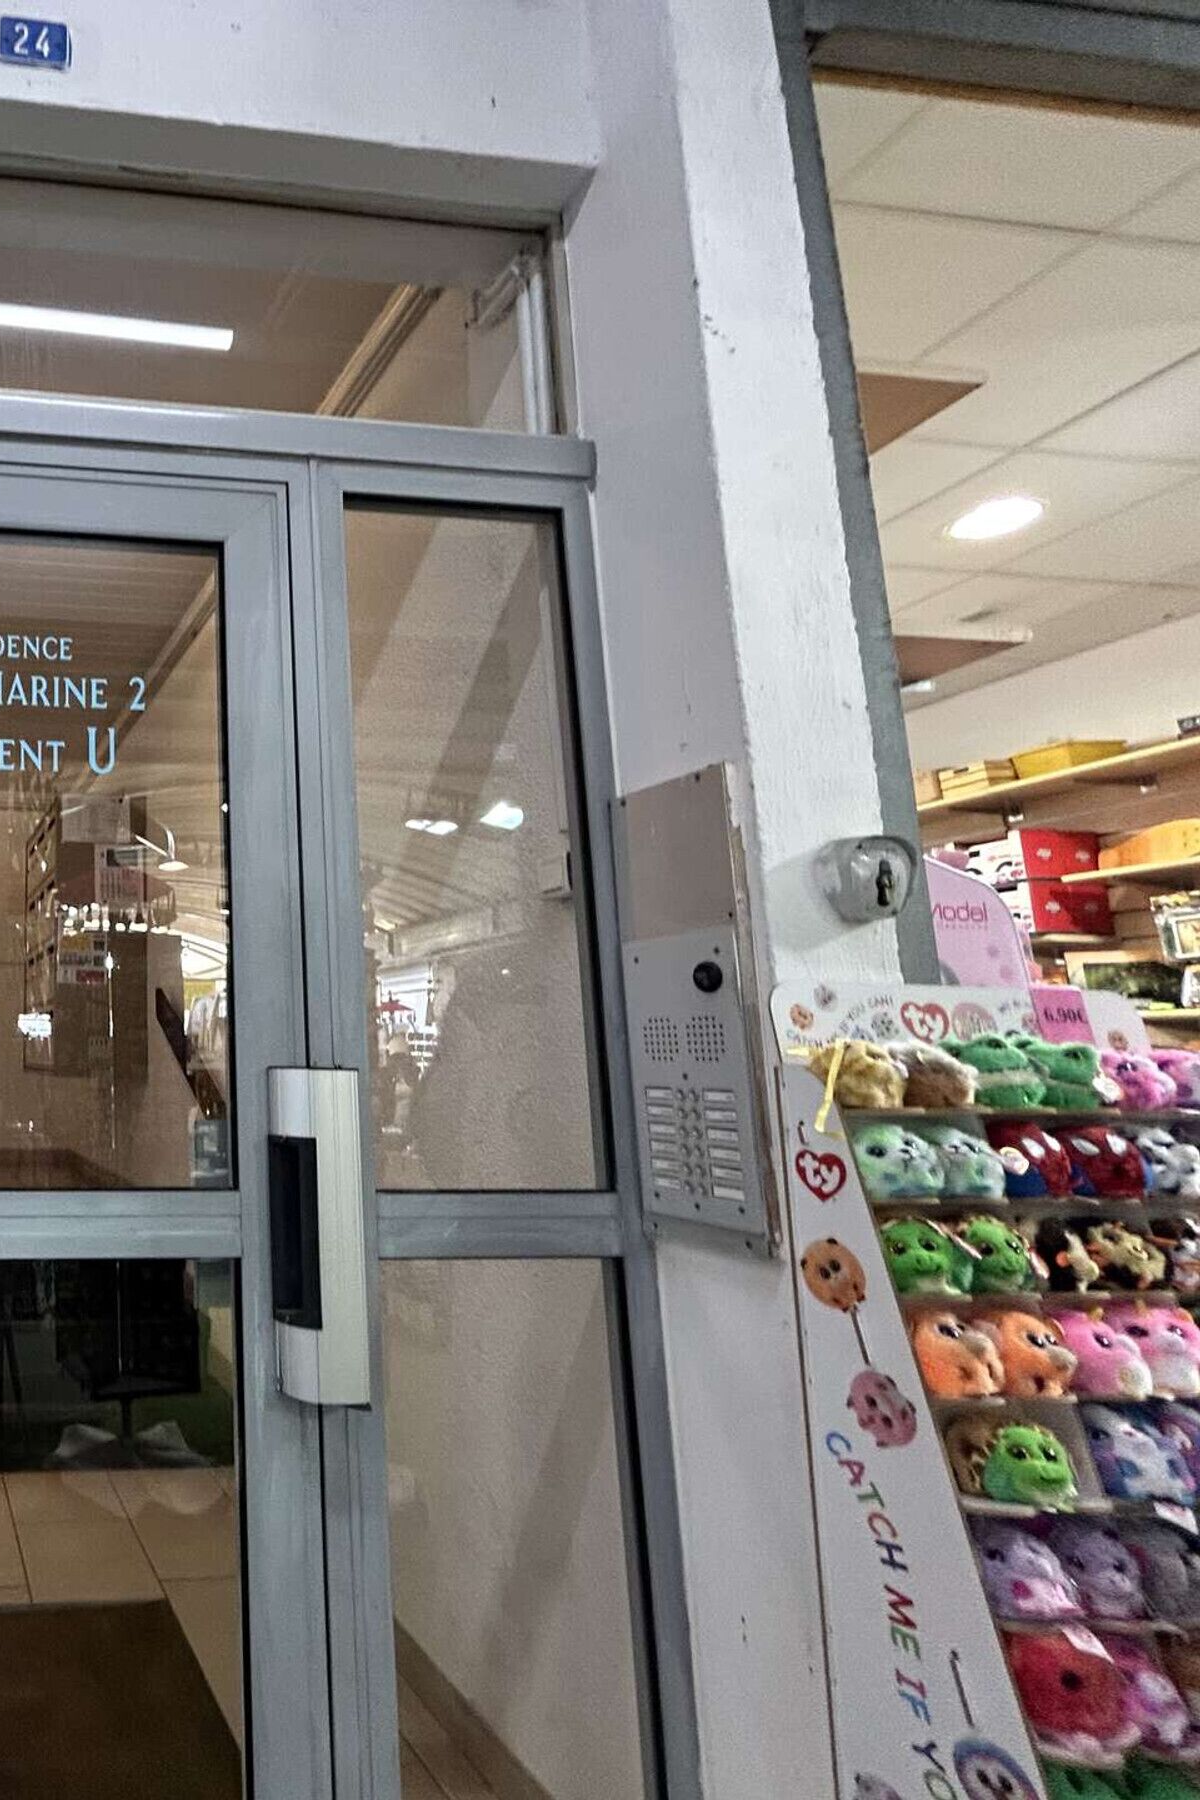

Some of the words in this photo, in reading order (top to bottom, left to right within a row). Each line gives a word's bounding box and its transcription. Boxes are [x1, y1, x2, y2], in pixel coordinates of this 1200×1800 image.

[13, 22, 50, 58] 24
[129, 677, 146, 711] 2
[87, 726, 117, 776] U
[825, 1431, 909, 1574] CATCH
[883, 1583, 922, 1662] ME
[895, 1668, 932, 1726] IF
